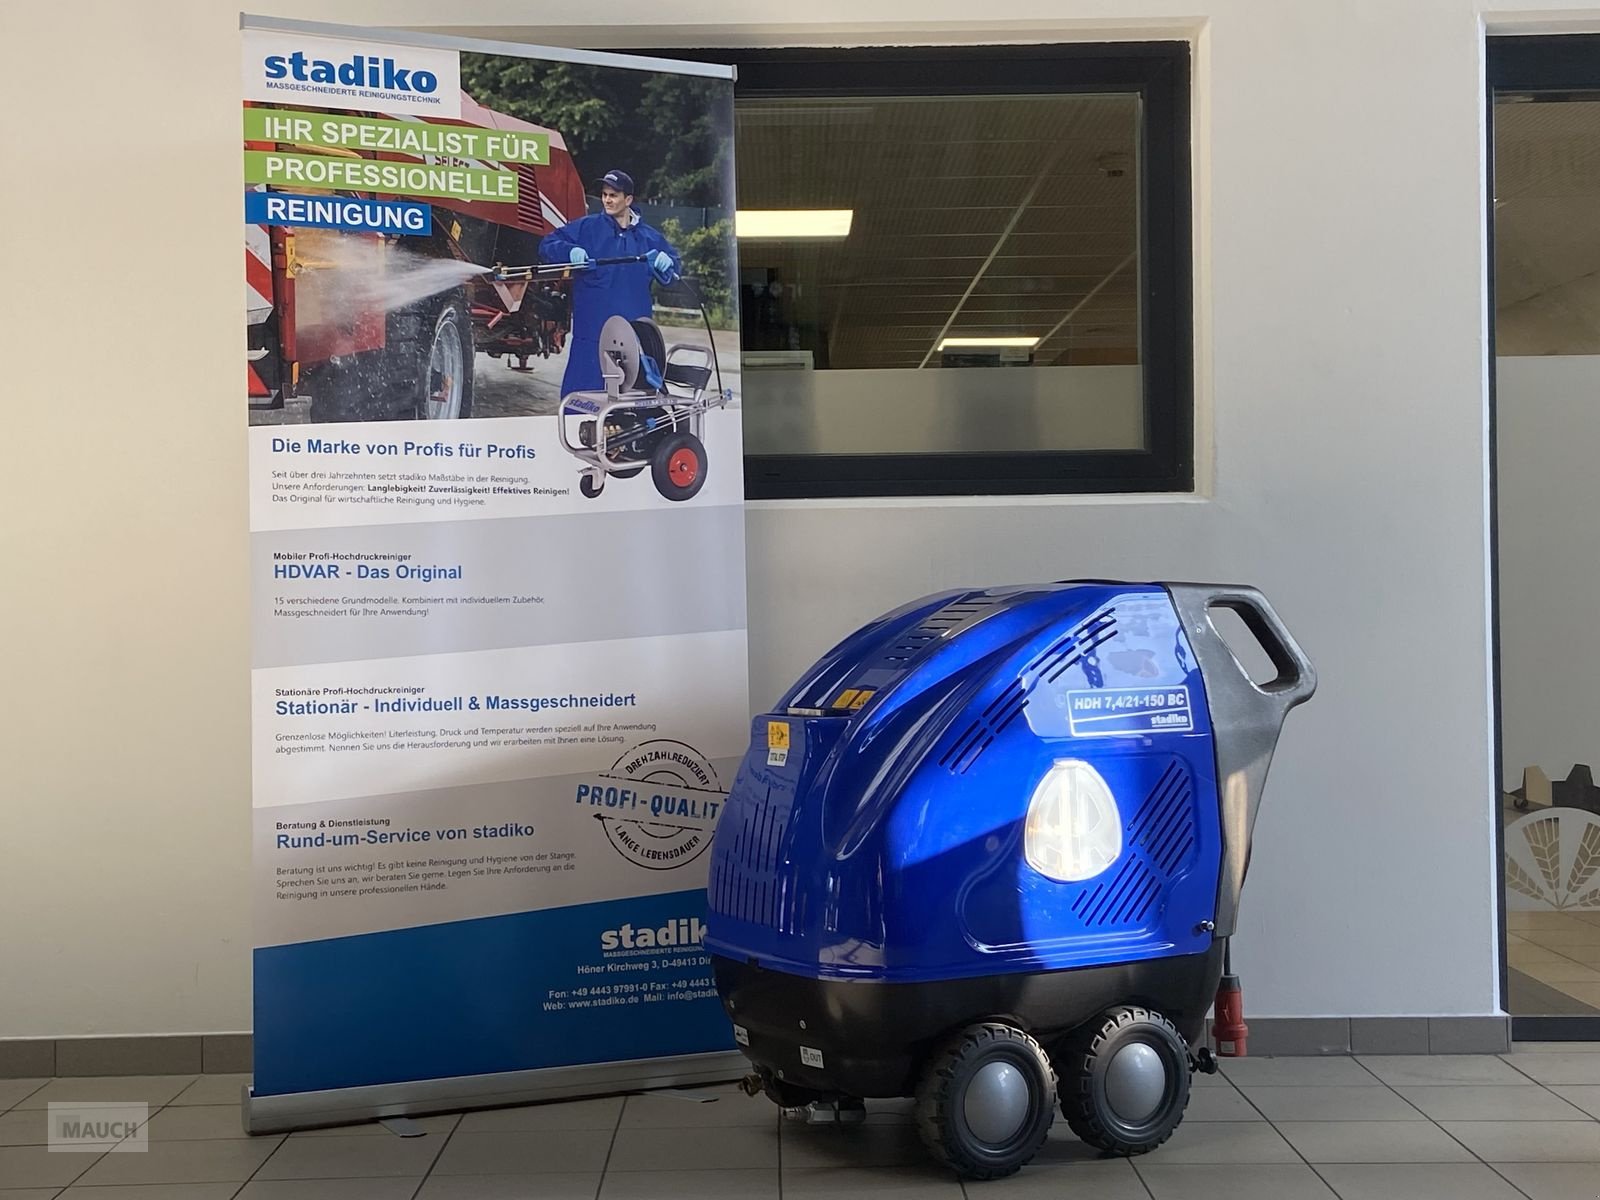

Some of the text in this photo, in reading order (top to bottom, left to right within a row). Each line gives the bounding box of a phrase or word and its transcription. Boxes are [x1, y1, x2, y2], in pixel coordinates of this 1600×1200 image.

[264, 52, 438, 93] stadiko
[266, 82, 441, 104] MASSGESCHNEIDERTE REINIGUNGSTECHNIK
[264, 117, 540, 161] IHR SPEZIALIST FÜR
[266, 156, 514, 198] PROFESSIONELLE
[267, 198, 425, 230] REINIGUNG
[272, 438, 536, 459] Die Marke von Profis für Profis
[272, 471, 288, 479] Seit
[290, 470, 308, 479] über
[310, 471, 326, 480] drei
[329, 471, 376, 480] Jahrzehnten
[378, 472, 396, 480] setzt
[398, 472, 426, 481] stadiko
[428, 474, 465, 482] Maßstäbe
[272, 482, 300, 490] Unsere
[368, 484, 426, 494] Langlebigkeit!
[428, 486, 490, 496] Zuverlässigkeit!
[492, 486, 532, 495] Effektives
[533, 488, 570, 496] Reinigen!
[272, 494, 288, 502] Das
[290, 494, 322, 504] Original
[324, 494, 336, 503] für
[338, 495, 395, 504] wirtschaftliche
[396, 496, 435, 506] Reinigung
[437, 497, 452, 505] und
[274, 552, 412, 562] Mobiler Profi-Hochdruckreiniger
[274, 564, 340, 579] HDVAR
[357, 564, 390, 579] Das
[396, 564, 462, 582] Original
[274, 596, 284, 605] 15
[286, 596, 340, 605] verschiedene
[402, 596, 444, 604] Kombiniert
[446, 596, 458, 604] mit
[460, 596, 510, 604] individuellem
[274, 608, 430, 618] Massgeschneidert für Ihre Anwendung!
[276, 686, 424, 696] Stationäre Profi-Hochdruckreiniger
[276, 699, 358, 716] Stationär
[375, 697, 462, 712] Individuell
[468, 696, 480, 710] &
[486, 693, 636, 712] Massgeschneidert
[1074, 693, 1184, 712] HDH 7,4/21-150 BC
[1151, 714, 1188, 725] stadiko
[275, 732, 326, 742] Grenzenlose
[328, 731, 386, 741] Möglichkeiten!
[440, 728, 462, 736] Druck
[464, 728, 478, 736] und
[481, 727, 524, 736] Temperatur
[526, 726, 552, 734] werden
[554, 724, 582, 734] speziell
[584, 724, 596, 732] auf
[597, 724, 611, 732] Ihre
[613, 722, 656, 732] Anwendung
[328, 744, 360, 752] Nennen
[363, 742, 374, 751] Sie
[392, 742, 405, 750] die
[408, 740, 471, 749] Herausforderung
[473, 739, 488, 748] und
[504, 738, 542, 746] erarbeiten
[557, 736, 578, 744] Ihnen
[580, 736, 596, 744] eine
[625, 751, 710, 786] DREHZAHLREDUZIERT
[576, 784, 723, 820] PROFI-QUALIT
[276, 818, 390, 830] Beratung & Dienstleistung
[276, 823, 535, 849] Rund-um-Service von stadiko
[614, 824, 701, 861] LANGE LEBENSDAUER
[276, 866, 314, 876] Beratung
[344, 862, 376, 872] wichtig!
[378, 862, 386, 870] Es
[388, 861, 404, 870] gibt
[406, 860, 426, 868] keine
[428, 857, 468, 868] Reinigung
[469, 856, 484, 864] und
[486, 855, 518, 865] Hygiene
[520, 854, 534, 862] von
[535, 852, 548, 860] der
[276, 879, 314, 888] Sprechen
[316, 878, 330, 886] Sie
[376, 874, 406, 882] beraten
[408, 872, 420, 880] Sie
[448, 870, 472, 879] Legen
[474, 868, 485, 876] Sie
[486, 867, 501, 875] Ihre
[503, 864, 551, 874] Anforderung
[276, 890, 318, 900] Reinigung
[358, 884, 418, 896] professionellen
[601, 917, 708, 950] stadik
[578, 965, 605, 974] Höner
[607, 961, 650, 972] Kirchweg
[652, 960, 660, 970] 3,
[662, 958, 696, 968] D-49413
[548, 990, 570, 999] Fon:
[571, 988, 588, 998] +49
[590, 986, 612, 995] 4443
[613, 983, 648, 994] 97991-0
[650, 982, 669, 990] Fax:
[672, 980, 688, 988] +49
[689, 978, 710, 987] 4443
[542, 989, 719, 1012] Web: www.stadiko.de Mail: info@stadik
[810, 1053, 822, 1064] OUT
